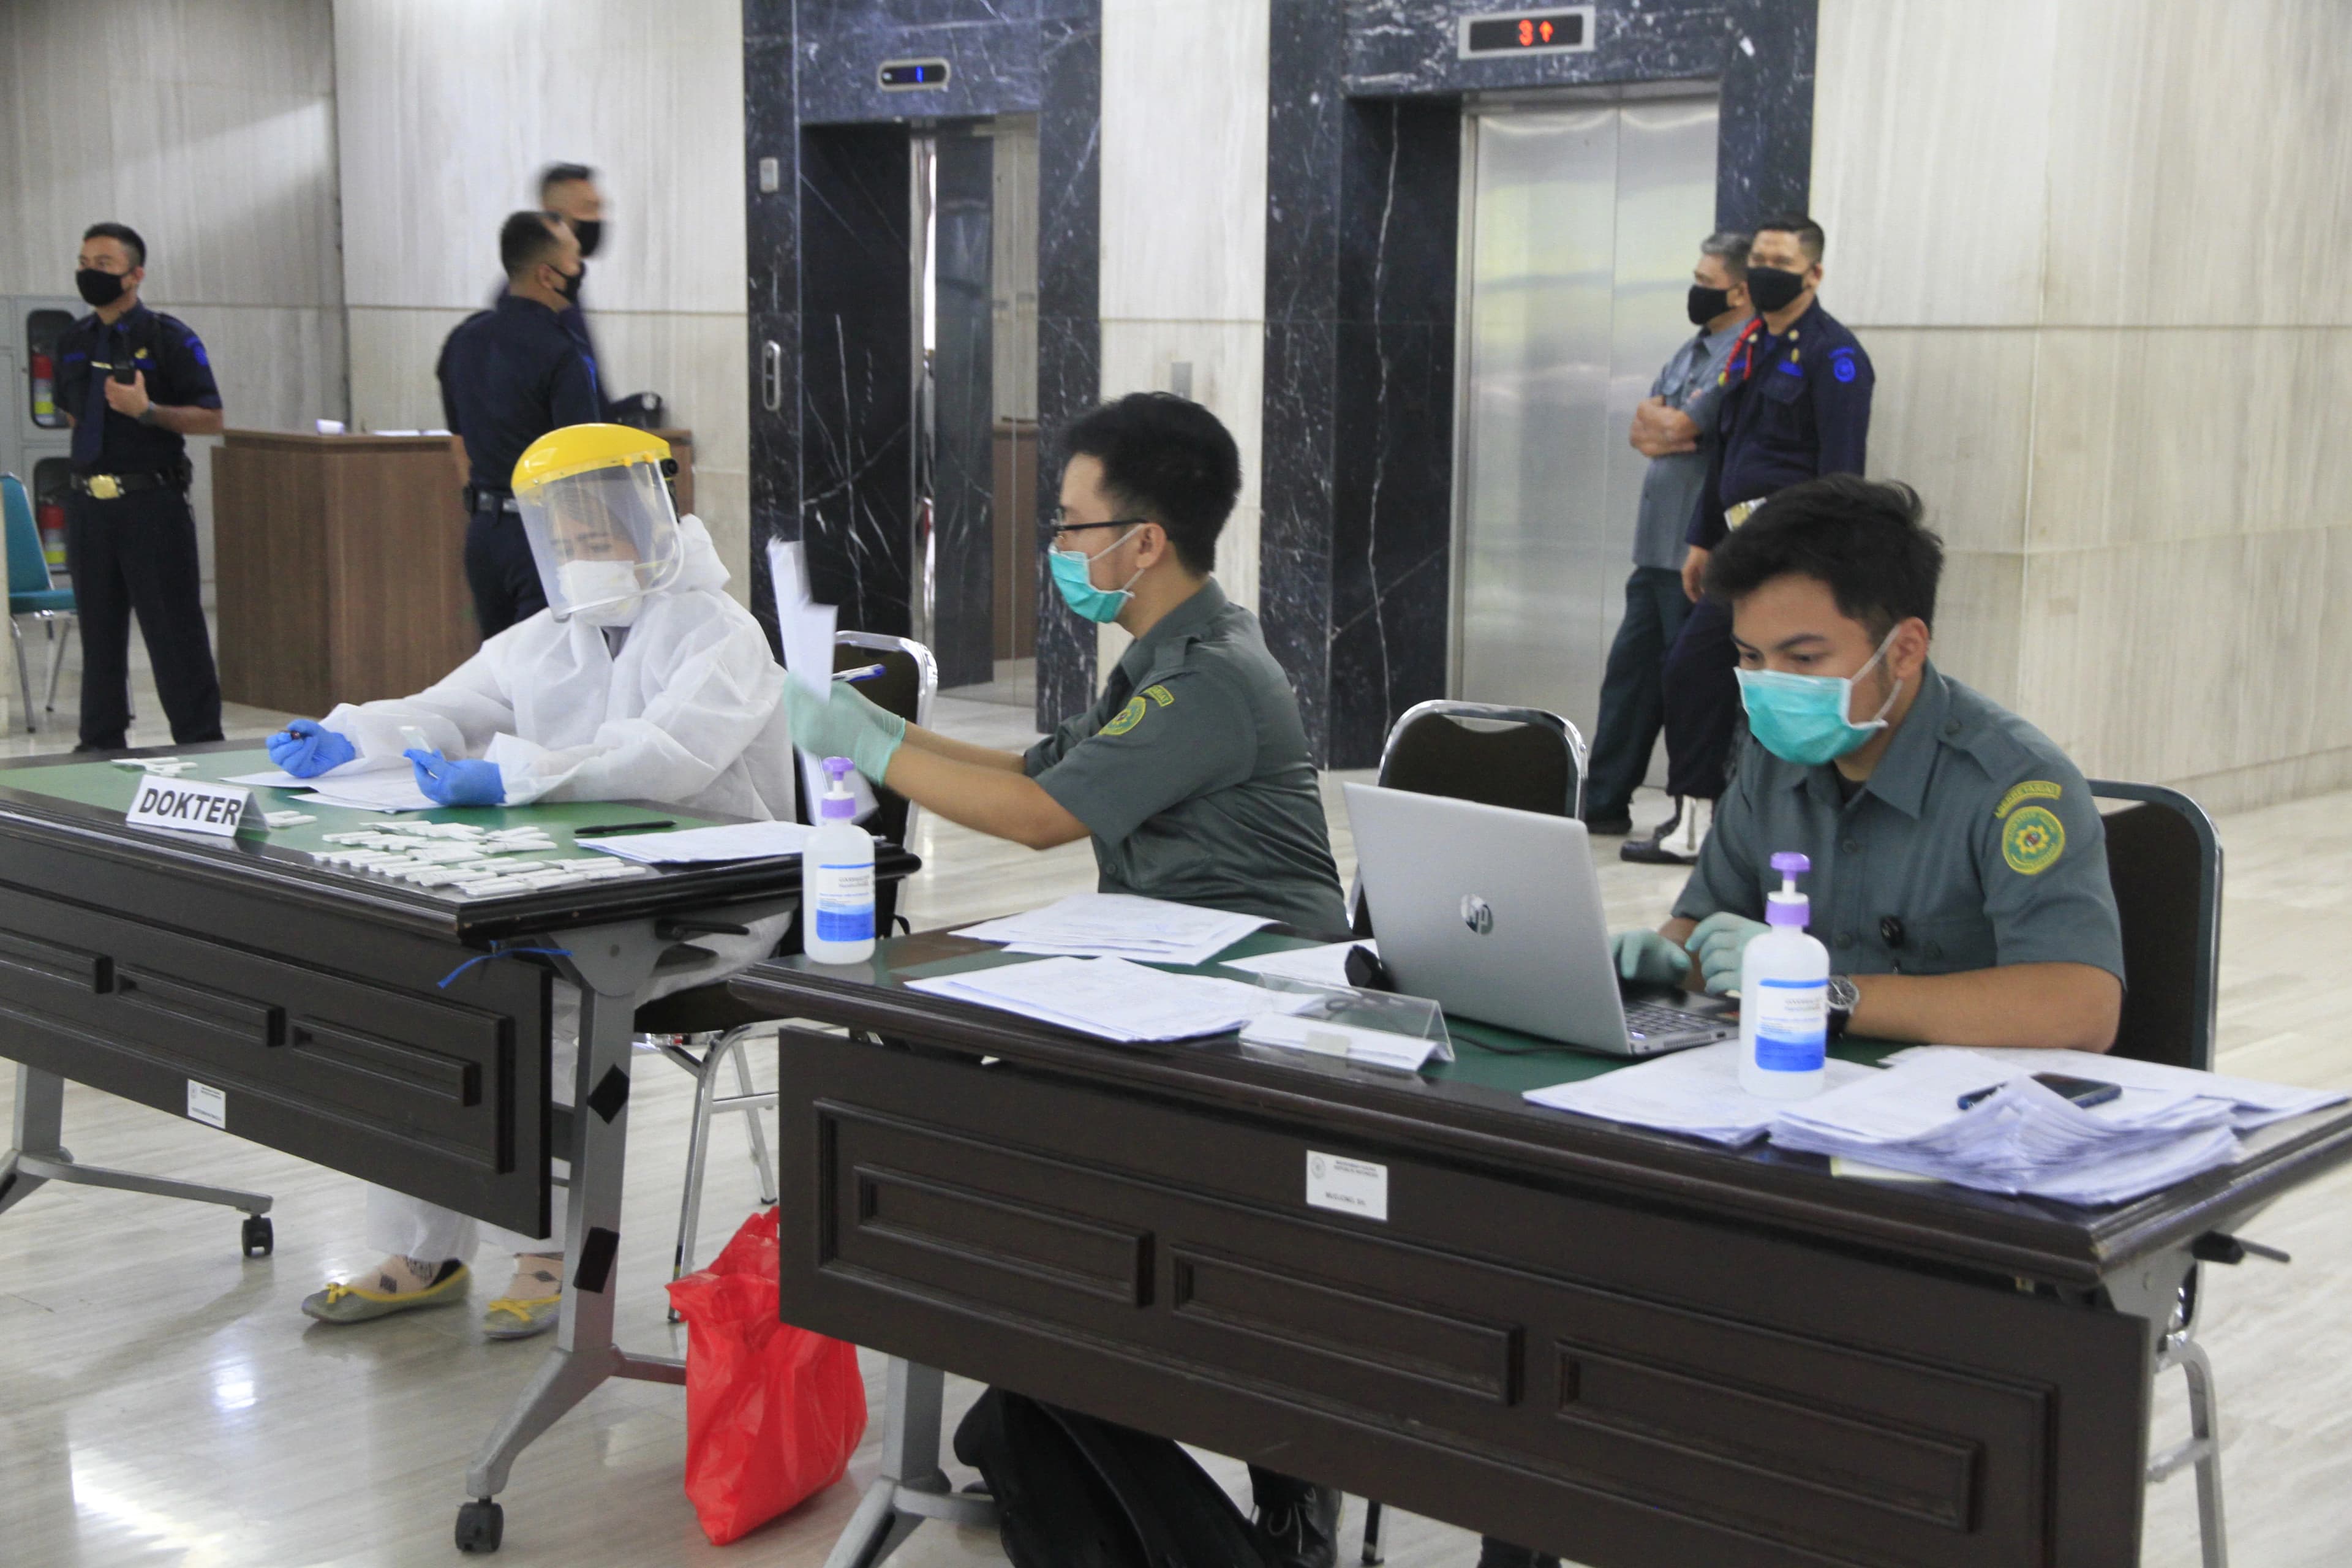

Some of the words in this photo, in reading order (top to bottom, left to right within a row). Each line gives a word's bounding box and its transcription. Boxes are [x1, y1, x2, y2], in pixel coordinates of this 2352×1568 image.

[1518, 19, 1534, 47] 3
[138, 787, 242, 826] DOKTER
[1461, 894, 1493, 935] hp
